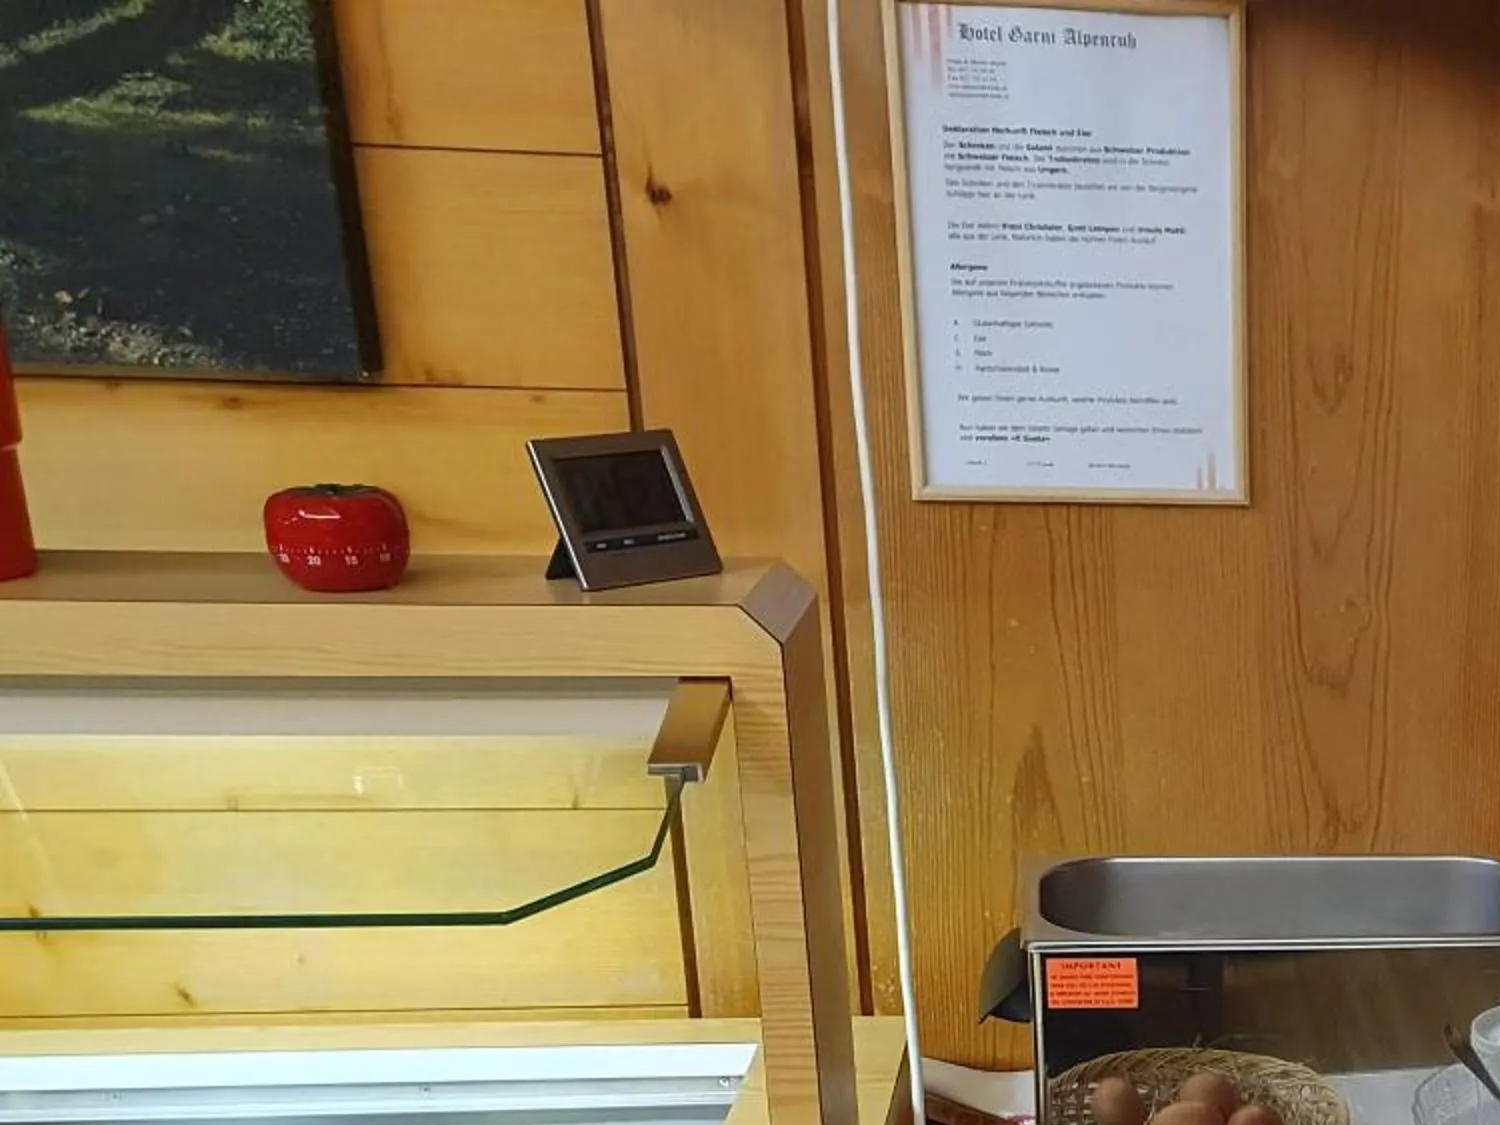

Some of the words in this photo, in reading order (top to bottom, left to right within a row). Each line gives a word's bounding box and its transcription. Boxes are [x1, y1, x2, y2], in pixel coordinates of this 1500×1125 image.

[957, 22, 1002, 42] Hotel
[1008, 25, 1056, 45] Garni
[1062, 27, 1138, 50] Alpenruh
